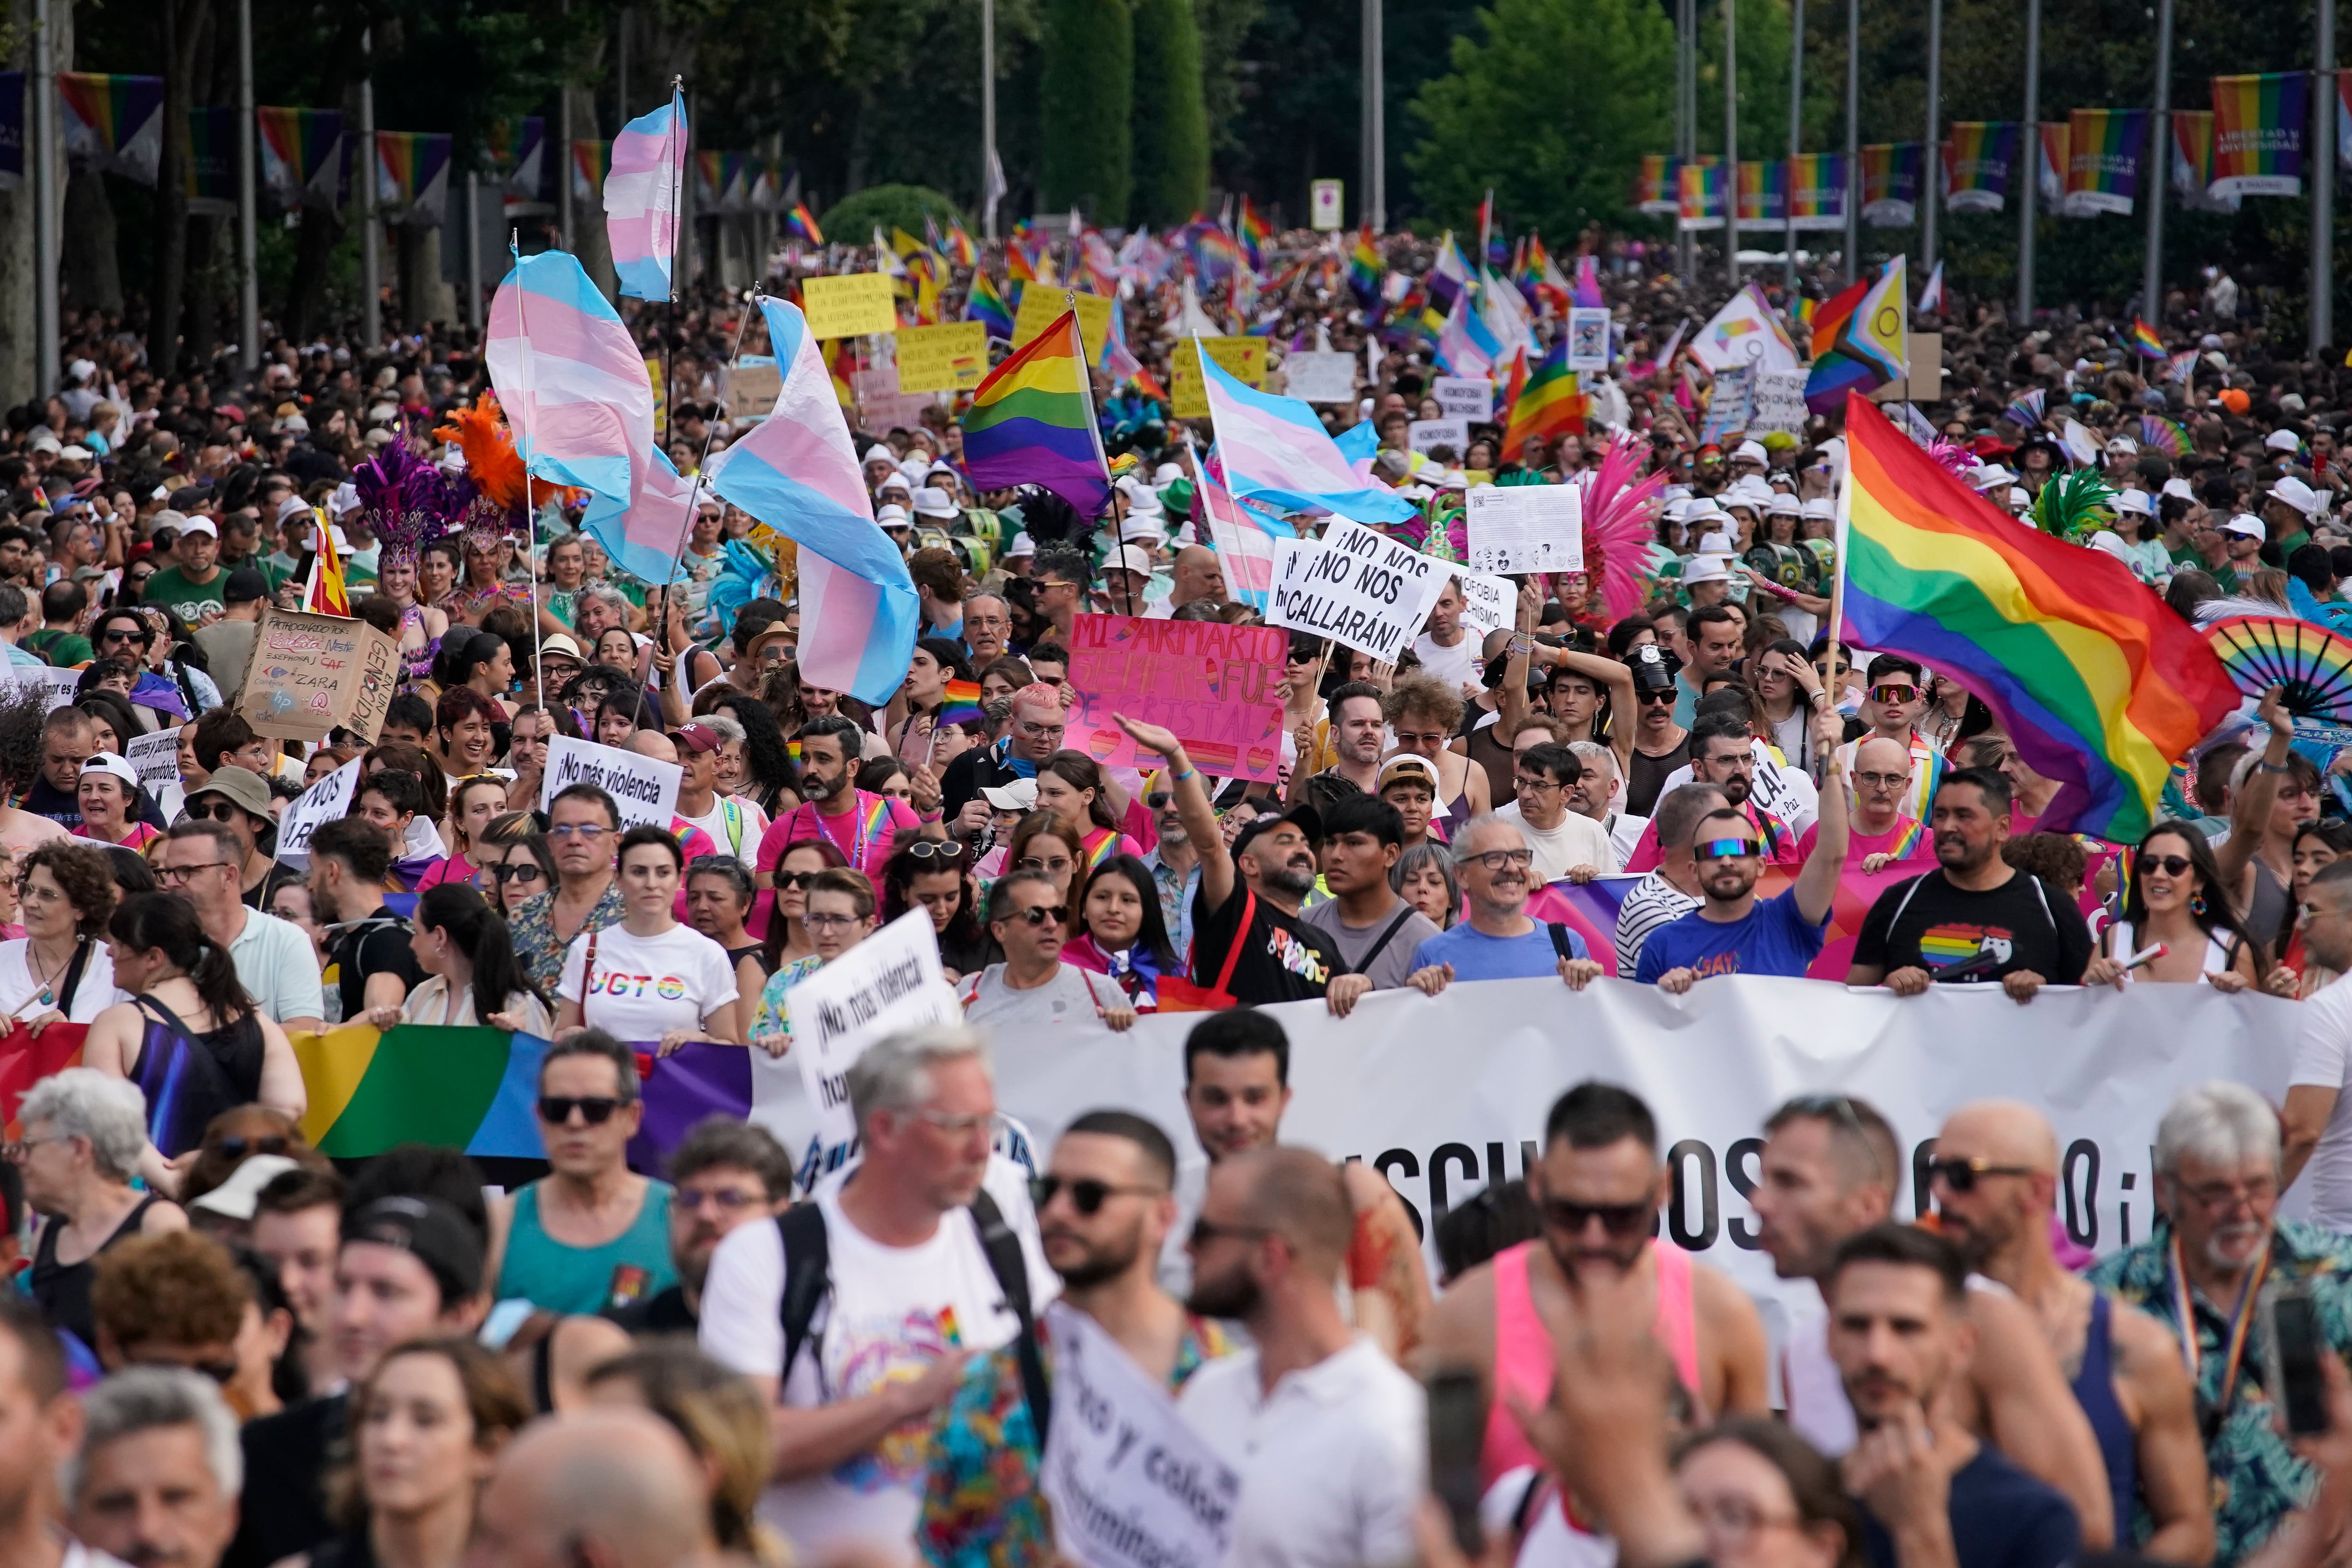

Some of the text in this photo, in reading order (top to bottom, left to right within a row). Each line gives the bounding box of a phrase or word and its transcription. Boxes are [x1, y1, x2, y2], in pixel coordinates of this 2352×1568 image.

[1303, 550, 1403, 605] ¡NO NOS
[1072, 613, 1285, 664] MI ARMARIO
[1286, 590, 1401, 654] CALLARÁN!
[61, 684, 72, 695] es
[295, 674, 339, 691] ZARA
[381, 673, 394, 692] EN
[1070, 649, 1279, 707] SIEMPRE FUE
[274, 691, 291, 714] hp
[1065, 690, 1100, 728] DE
[303, 770, 343, 807] NOS
[556, 752, 661, 804] ¡No más violencia
[1784, 798, 1800, 814] Paz
[589, 971, 652, 997] UGT
